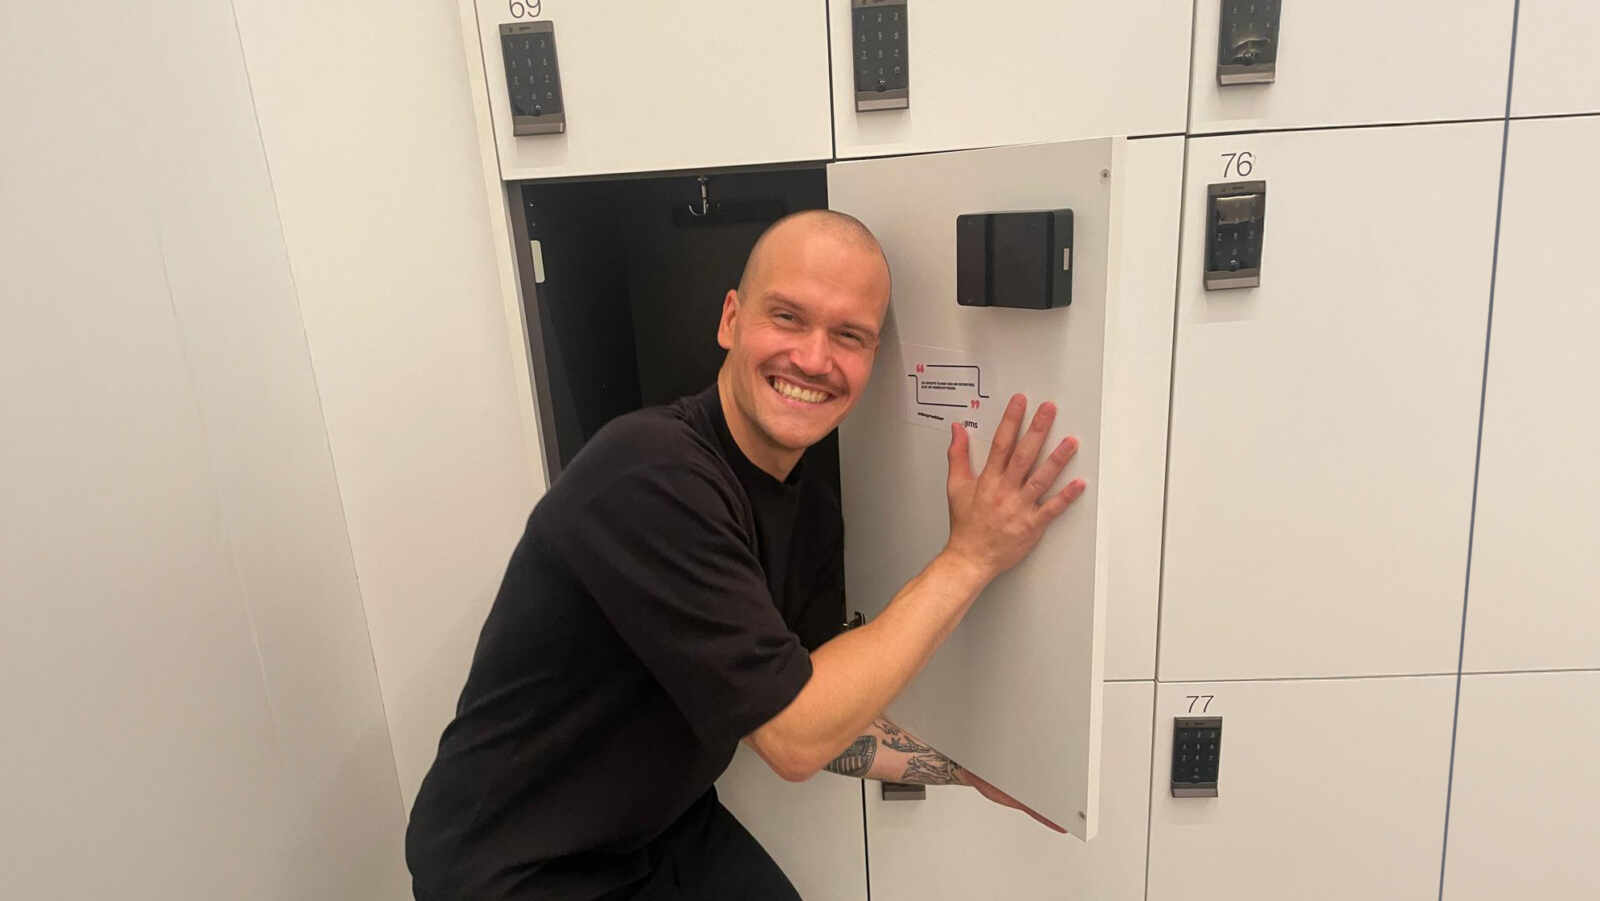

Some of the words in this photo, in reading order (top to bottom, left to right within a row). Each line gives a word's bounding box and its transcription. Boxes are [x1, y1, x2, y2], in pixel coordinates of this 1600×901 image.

[509, 0, 541, 18] 69
[1221, 151, 1253, 178] 76
[1186, 695, 1215, 713] 77
